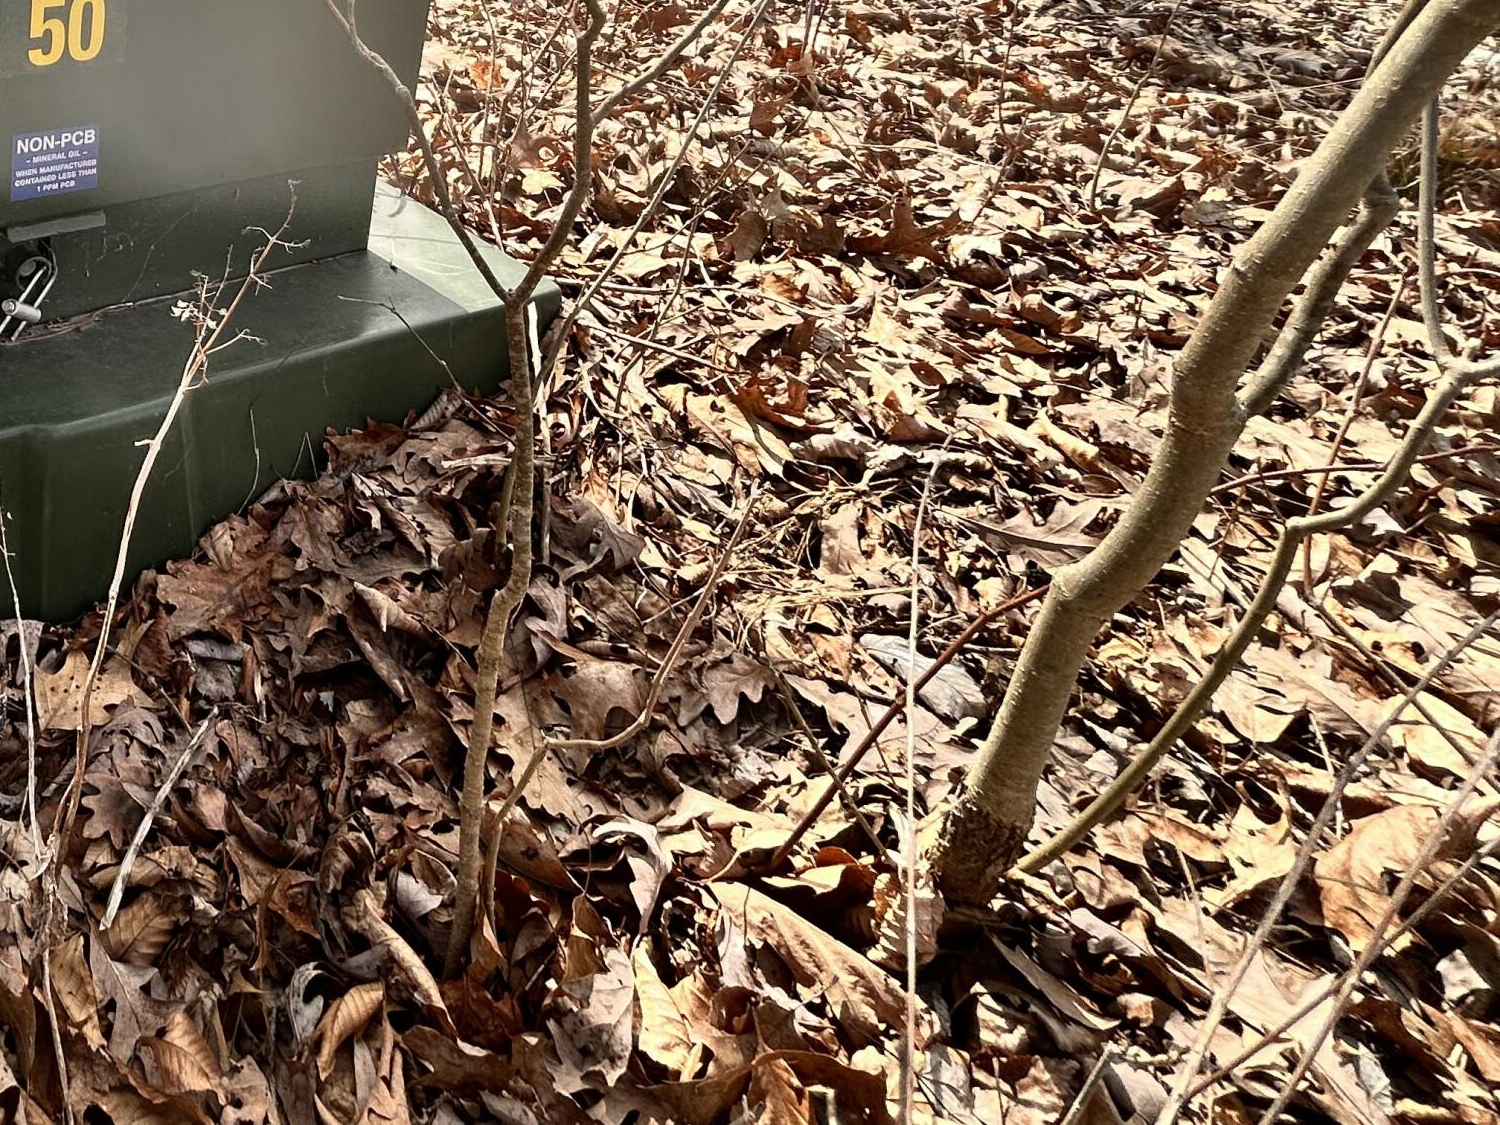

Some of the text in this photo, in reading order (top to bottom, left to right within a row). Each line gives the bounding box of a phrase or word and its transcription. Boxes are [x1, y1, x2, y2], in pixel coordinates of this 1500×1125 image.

[16, 129, 96, 154] NON-PCB
[32, 152, 67, 163] MINERAL
[68, 150, 81, 158] OIL
[14, 167, 97, 187] CONTAINED LESS THAN
[15, 159, 97, 177] WHEN MANUFACTURED
[42, 183, 59, 191] PPM
[60, 180, 76, 188] PCB
